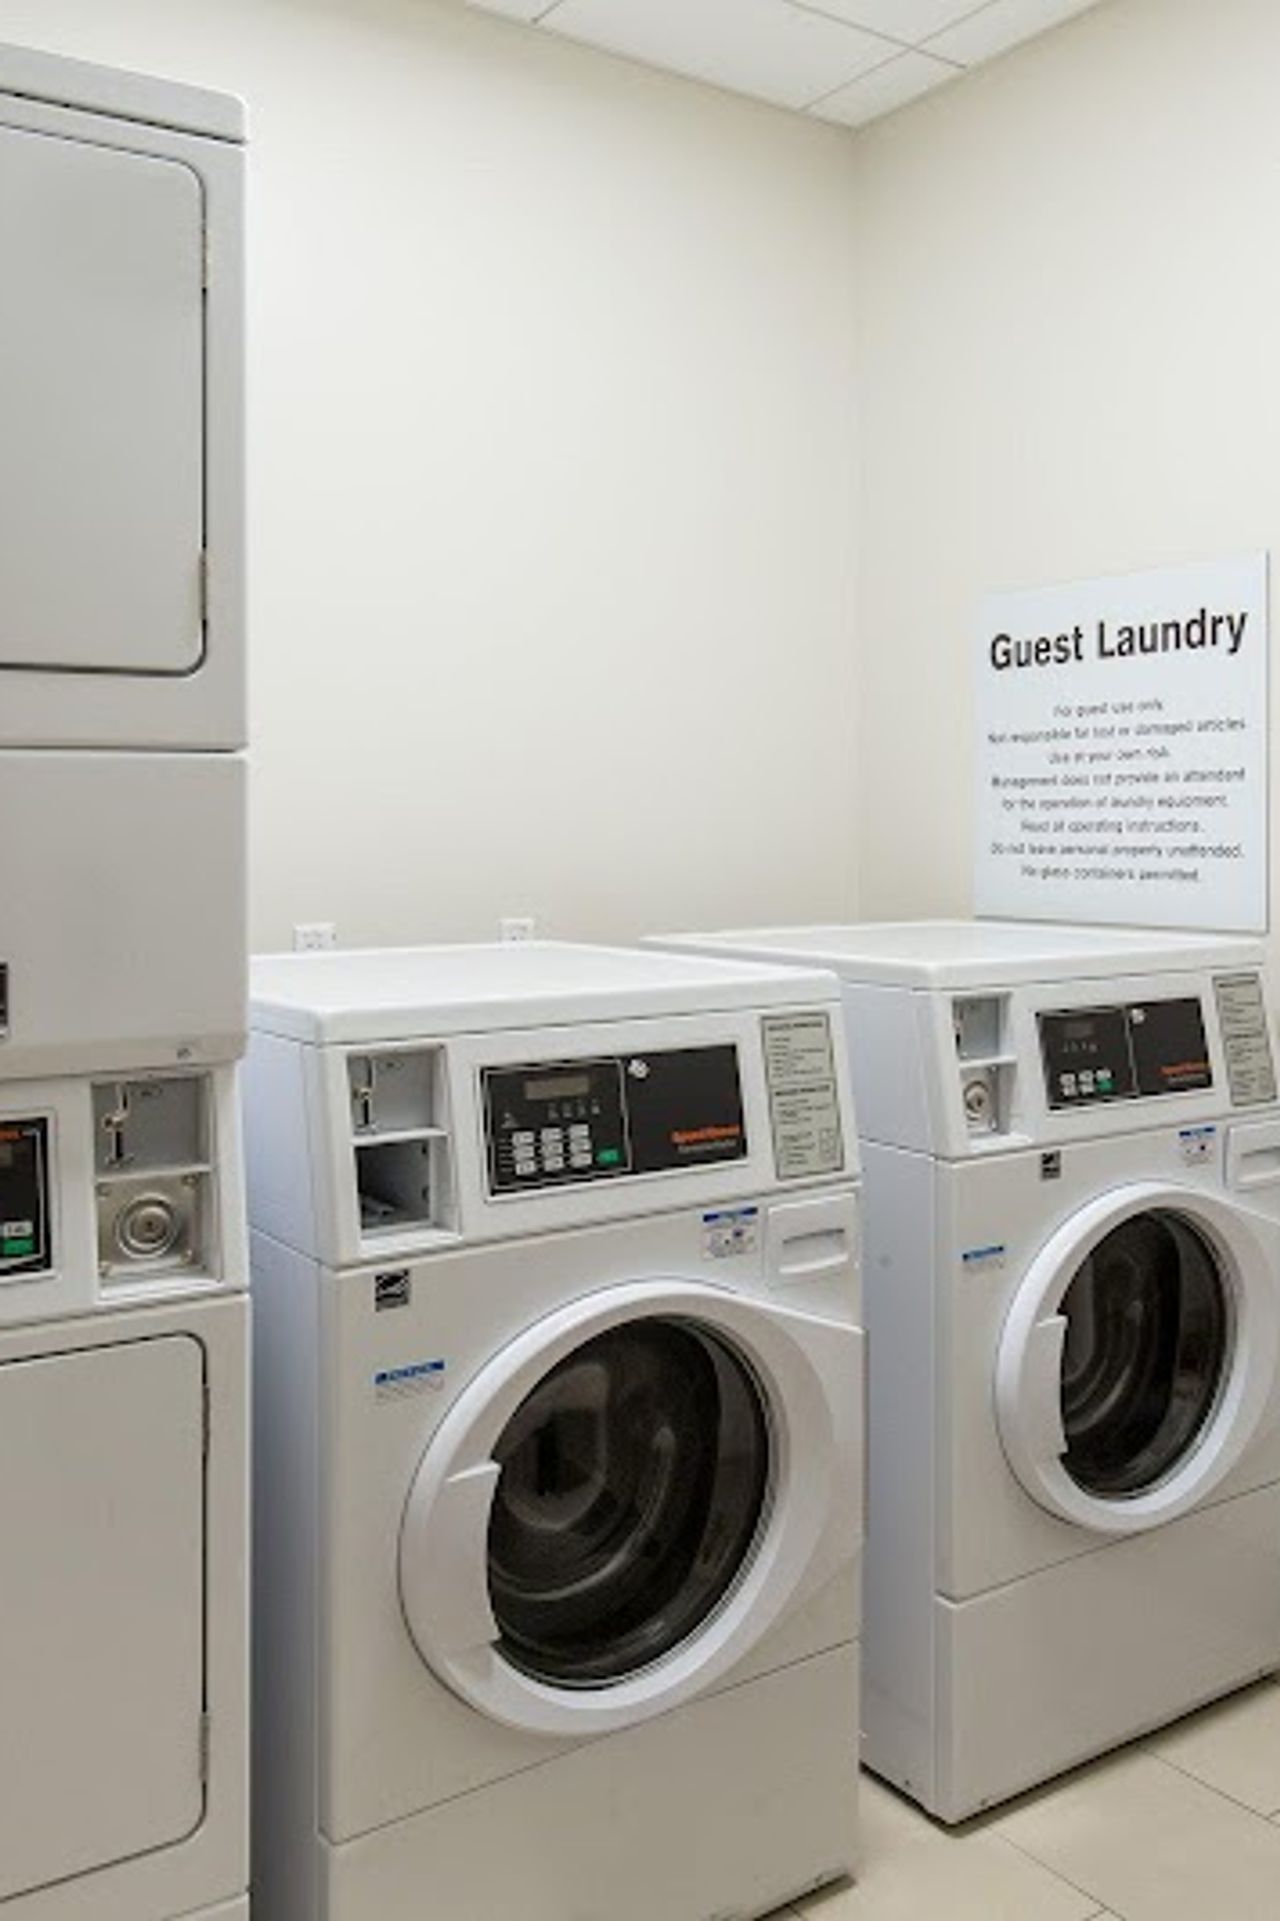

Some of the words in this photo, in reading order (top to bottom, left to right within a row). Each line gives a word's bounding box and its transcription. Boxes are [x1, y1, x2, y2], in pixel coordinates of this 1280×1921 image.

[990, 626, 1084, 671] Guest
[1098, 608, 1247, 660] Laundry
[1077, 702, 1108, 718] guest
[1112, 702, 1133, 715] use
